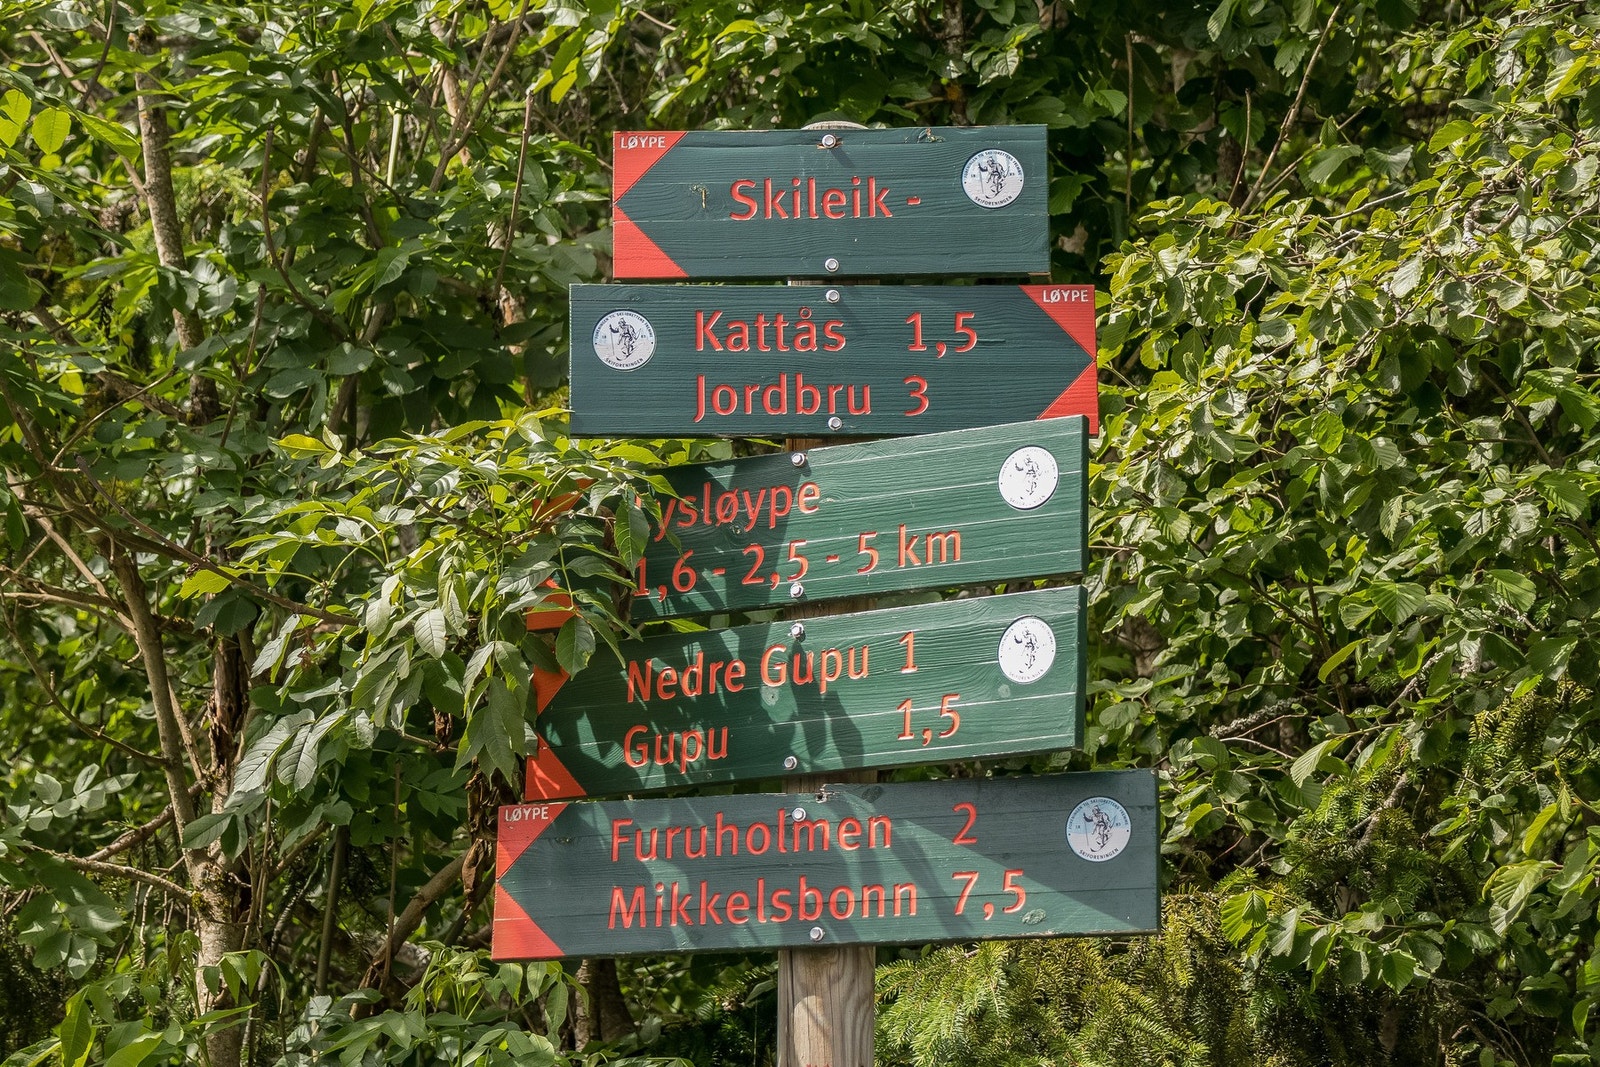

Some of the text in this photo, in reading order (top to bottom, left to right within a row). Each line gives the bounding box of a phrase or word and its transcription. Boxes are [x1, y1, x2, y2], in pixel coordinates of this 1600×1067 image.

[620, 135, 666, 149] LØYPE
[729, 176, 893, 221] Skileik
[1042, 289, 1089, 303] LØYPE
[694, 307, 978, 359] Kattås 1,5
[692, 372, 930, 423] Jordbru 3
[635, 481, 821, 543] ysløype
[633, 549, 698, 602] 1,6
[740, 539, 810, 590] 2,5
[857, 530, 880, 575] 5
[897, 523, 962, 568] km
[626, 630, 918, 704] Nedre Gupu 1
[623, 692, 961, 775] Gupu 1,5
[505, 806, 549, 822] LØYPE
[610, 802, 978, 863] Furuholmen 2
[606, 868, 1027, 931] Mikkelsbonn 7,5
